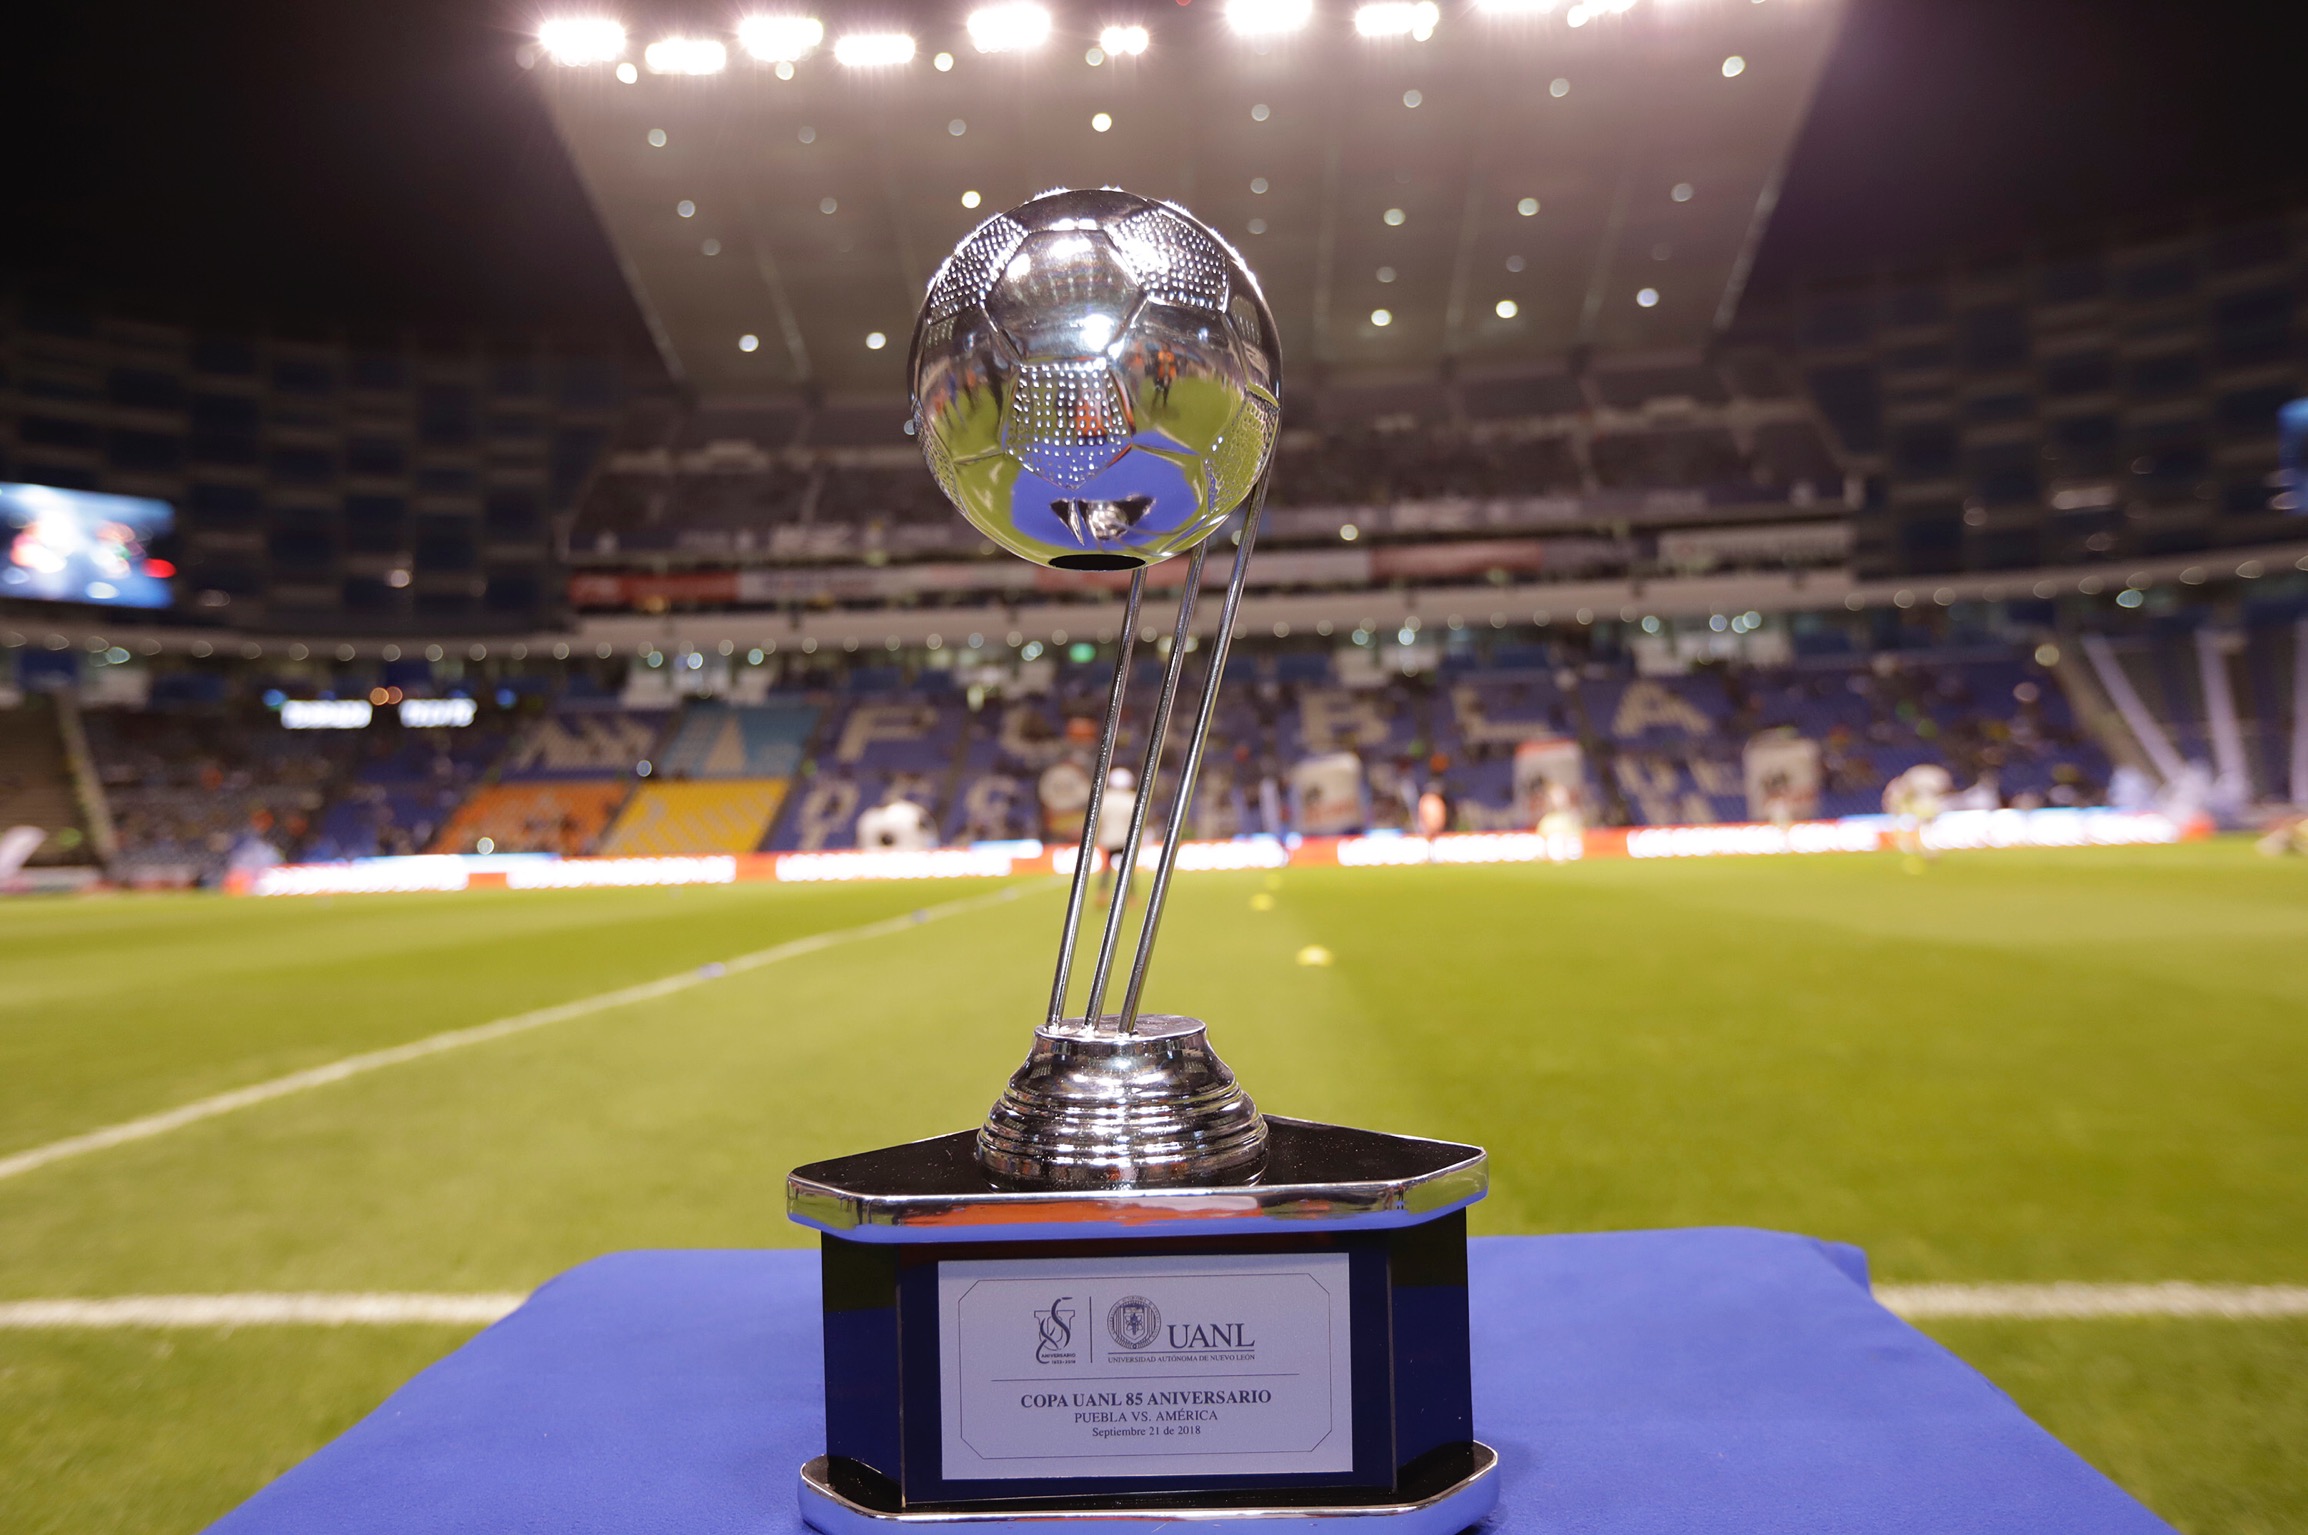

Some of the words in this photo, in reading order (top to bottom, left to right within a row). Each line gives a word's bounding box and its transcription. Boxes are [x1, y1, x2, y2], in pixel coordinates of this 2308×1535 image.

[1166, 1323, 1256, 1349] UANL
[1157, 1354, 1198, 1362] AUTÓNOMA
[1021, 1394, 1068, 1408] COPA
[1072, 1392, 1122, 1407] UANL
[1125, 1392, 1143, 1406] 85
[1147, 1390, 1271, 1405] ANIVERSARIO
[1074, 1411, 1127, 1423] PUEBLA
[1131, 1410, 1152, 1422] VS.
[1155, 1408, 1218, 1421] AMÉRICA
[1092, 1426, 1146, 1438] Septiembre
[1149, 1426, 1160, 1435] 21
[1163, 1425, 1175, 1435] de
[1178, 1425, 1201, 1435] 2018
